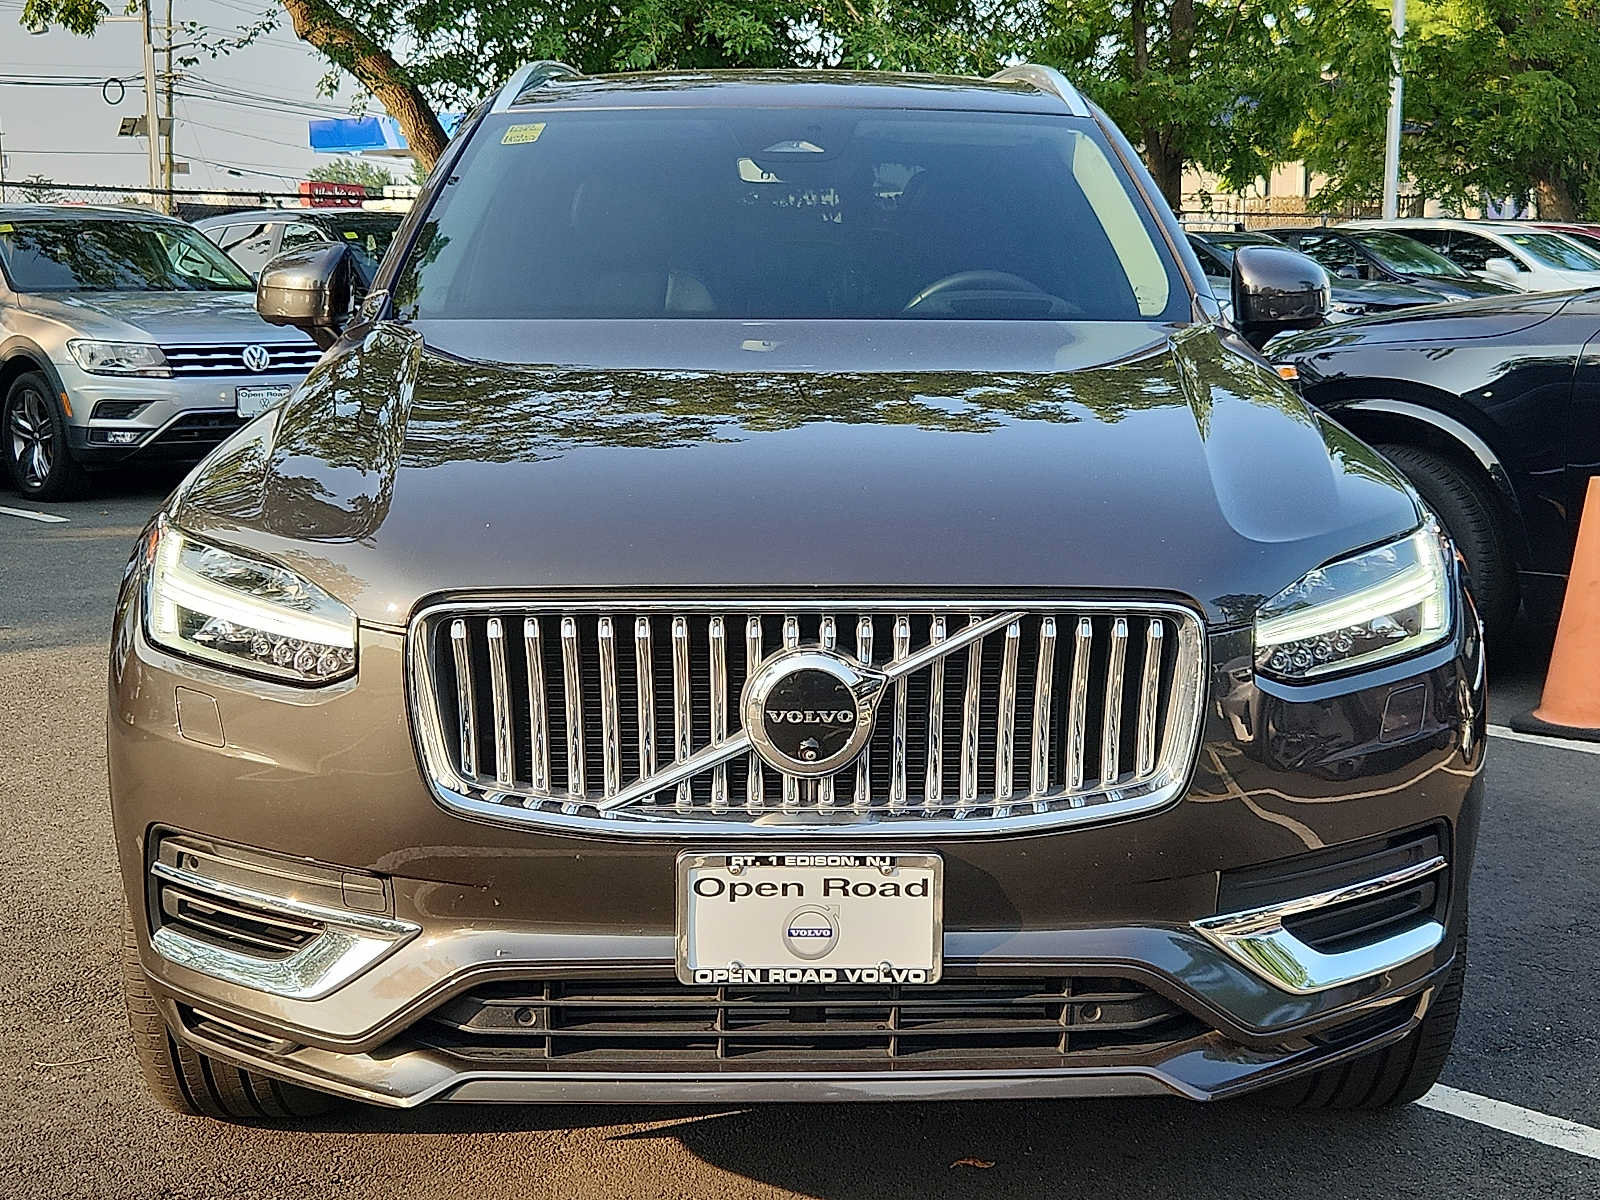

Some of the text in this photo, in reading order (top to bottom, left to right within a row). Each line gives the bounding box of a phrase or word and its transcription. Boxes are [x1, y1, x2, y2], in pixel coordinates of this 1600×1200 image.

[240, 391, 264, 399] Open
[766, 710, 854, 724] VOLVO
[731, 856, 891, 868] RT. 1 EDISON, NJ
[693, 877, 929, 903] Open Road
[790, 929, 831, 937] VOLVO
[695, 969, 927, 984] OPEN ROAD VOLVO
